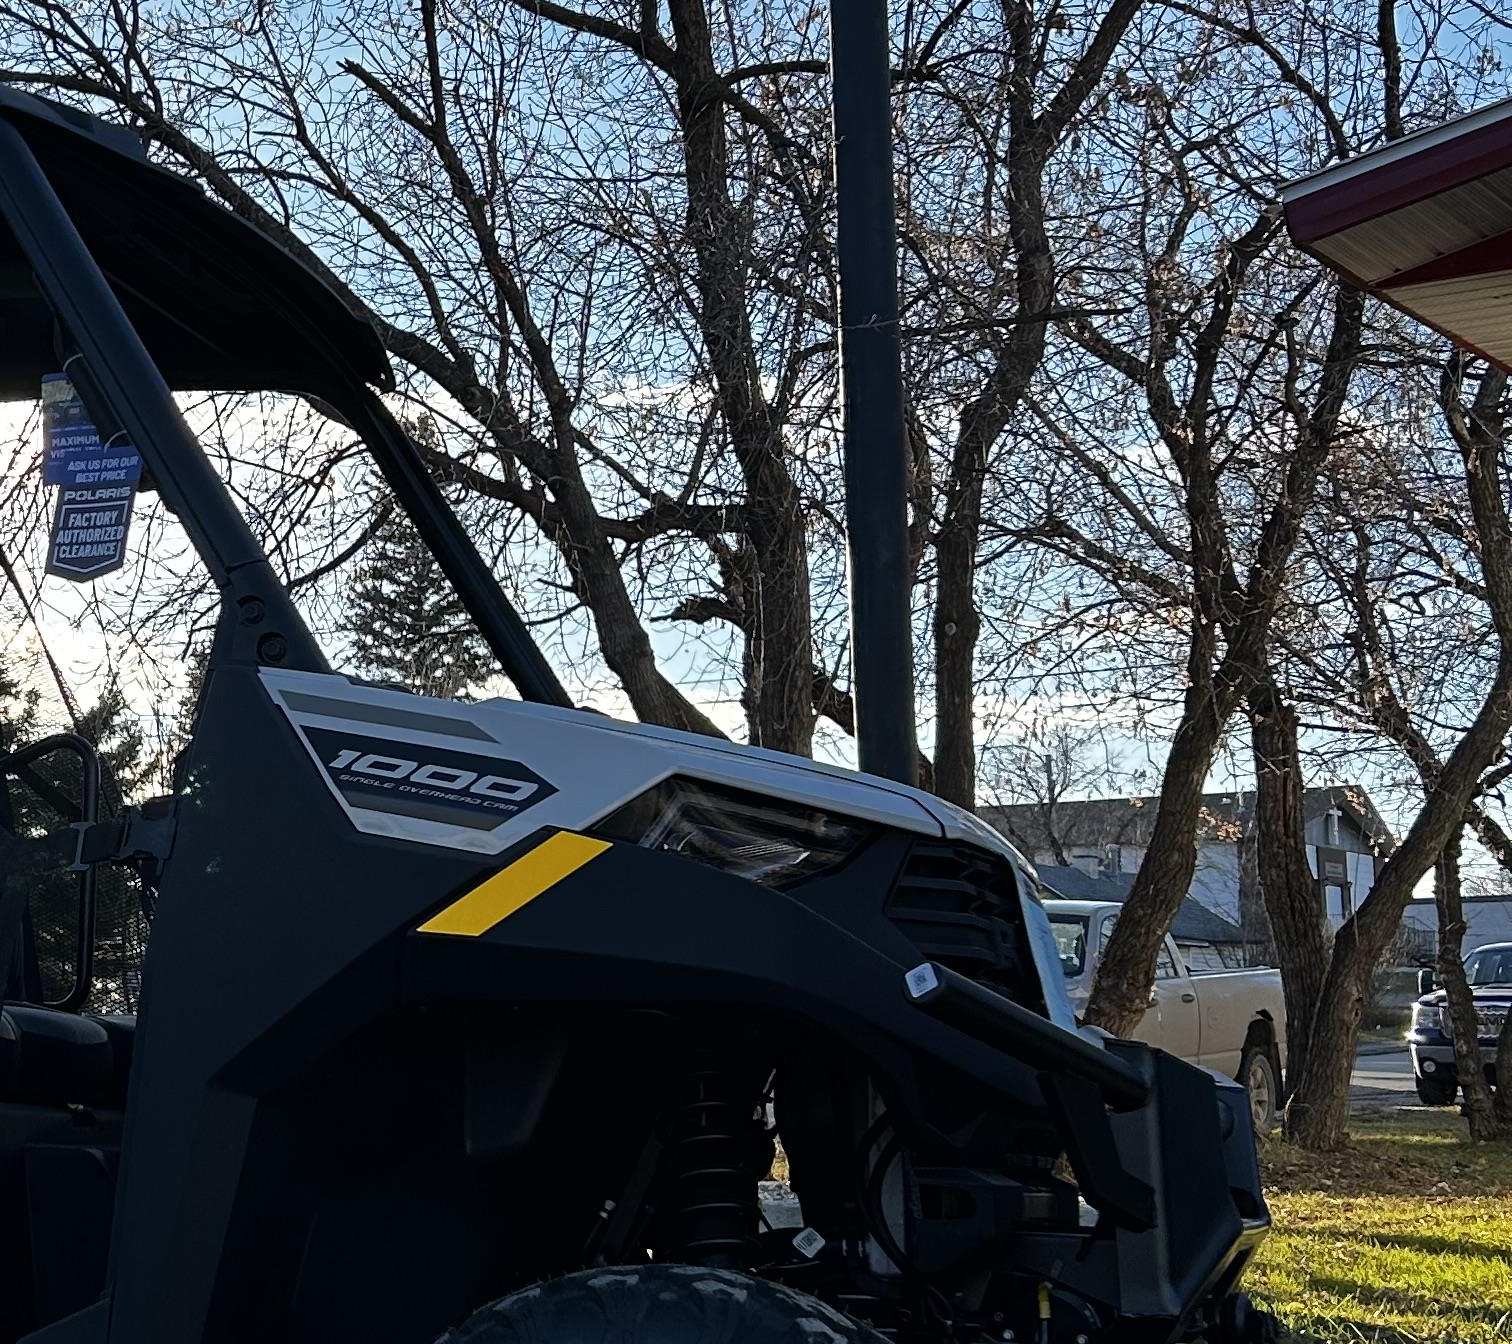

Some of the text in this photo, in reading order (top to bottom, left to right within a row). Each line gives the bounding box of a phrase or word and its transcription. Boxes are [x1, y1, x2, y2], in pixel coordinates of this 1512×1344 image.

[51, 435, 100, 447] MAXIMUM
[68, 460, 86, 471] ASK
[88, 459, 100, 470] US
[101, 458, 120, 469] FOR
[120, 455, 139, 467] OUR
[75, 469, 127, 483] BEST PRICE
[64, 486, 131, 501] POLARIS
[69, 510, 118, 527] FACTORY
[56, 526, 124, 543] AUTHORIZED
[58, 541, 118, 558] CLEARANCE
[329, 749, 539, 801] 1000
[338, 774, 520, 812] SINGLE OVERHEAD CAM
